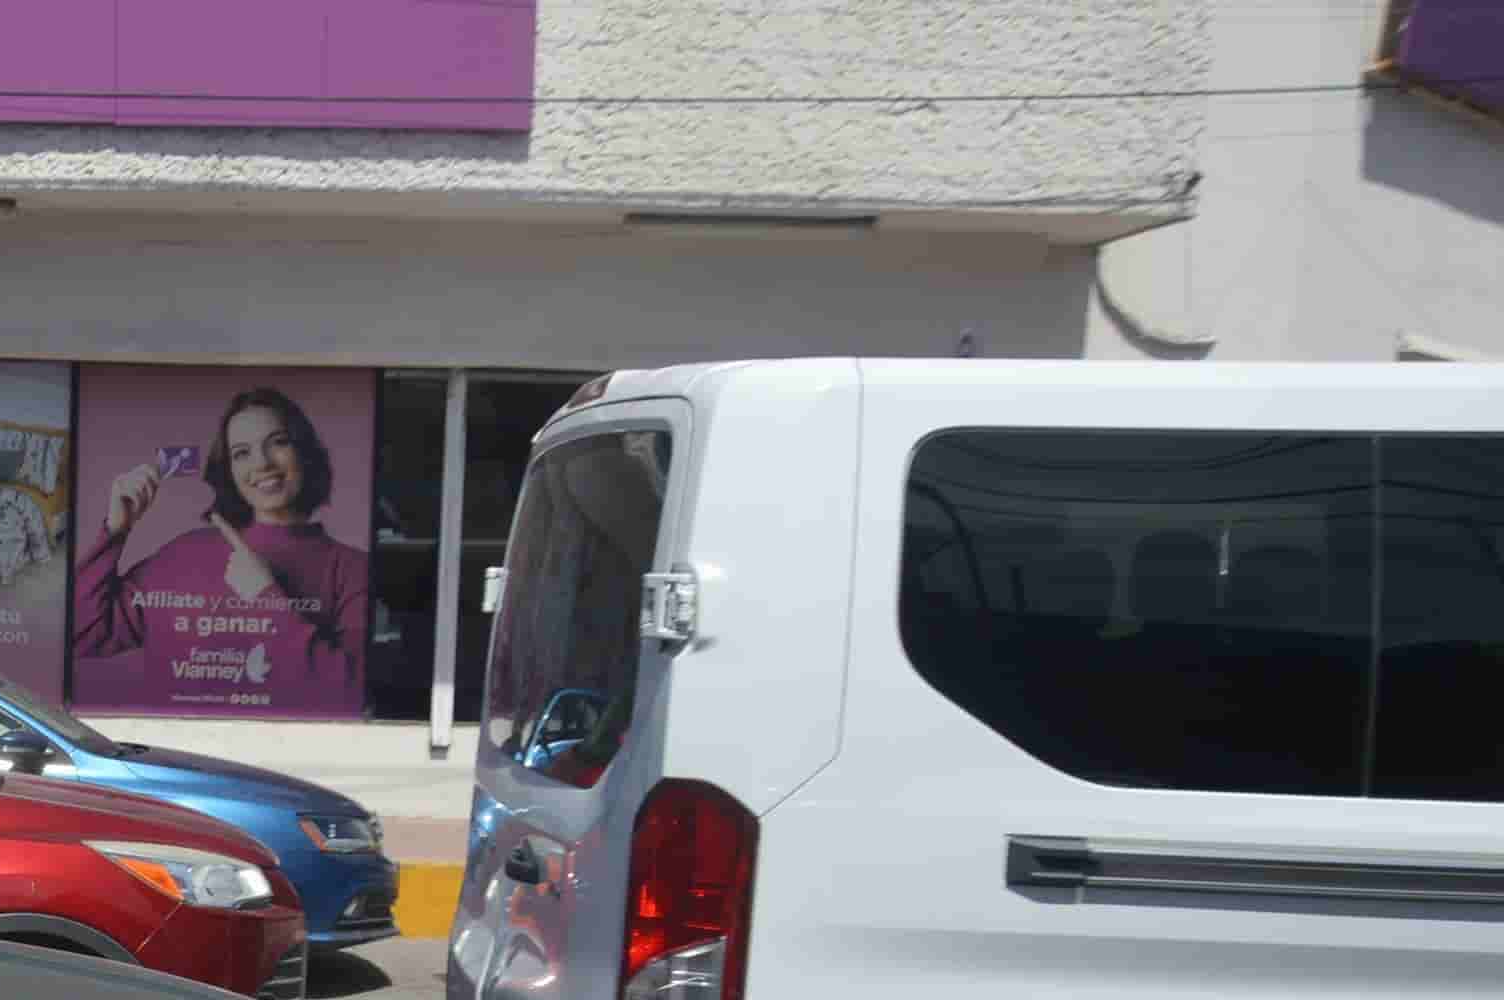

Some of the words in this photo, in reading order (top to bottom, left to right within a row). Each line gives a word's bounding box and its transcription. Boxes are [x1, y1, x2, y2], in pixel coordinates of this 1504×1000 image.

[174, 618, 190, 632] a
[197, 616, 278, 636] ganar.
[172, 659, 244, 682] Vianney
